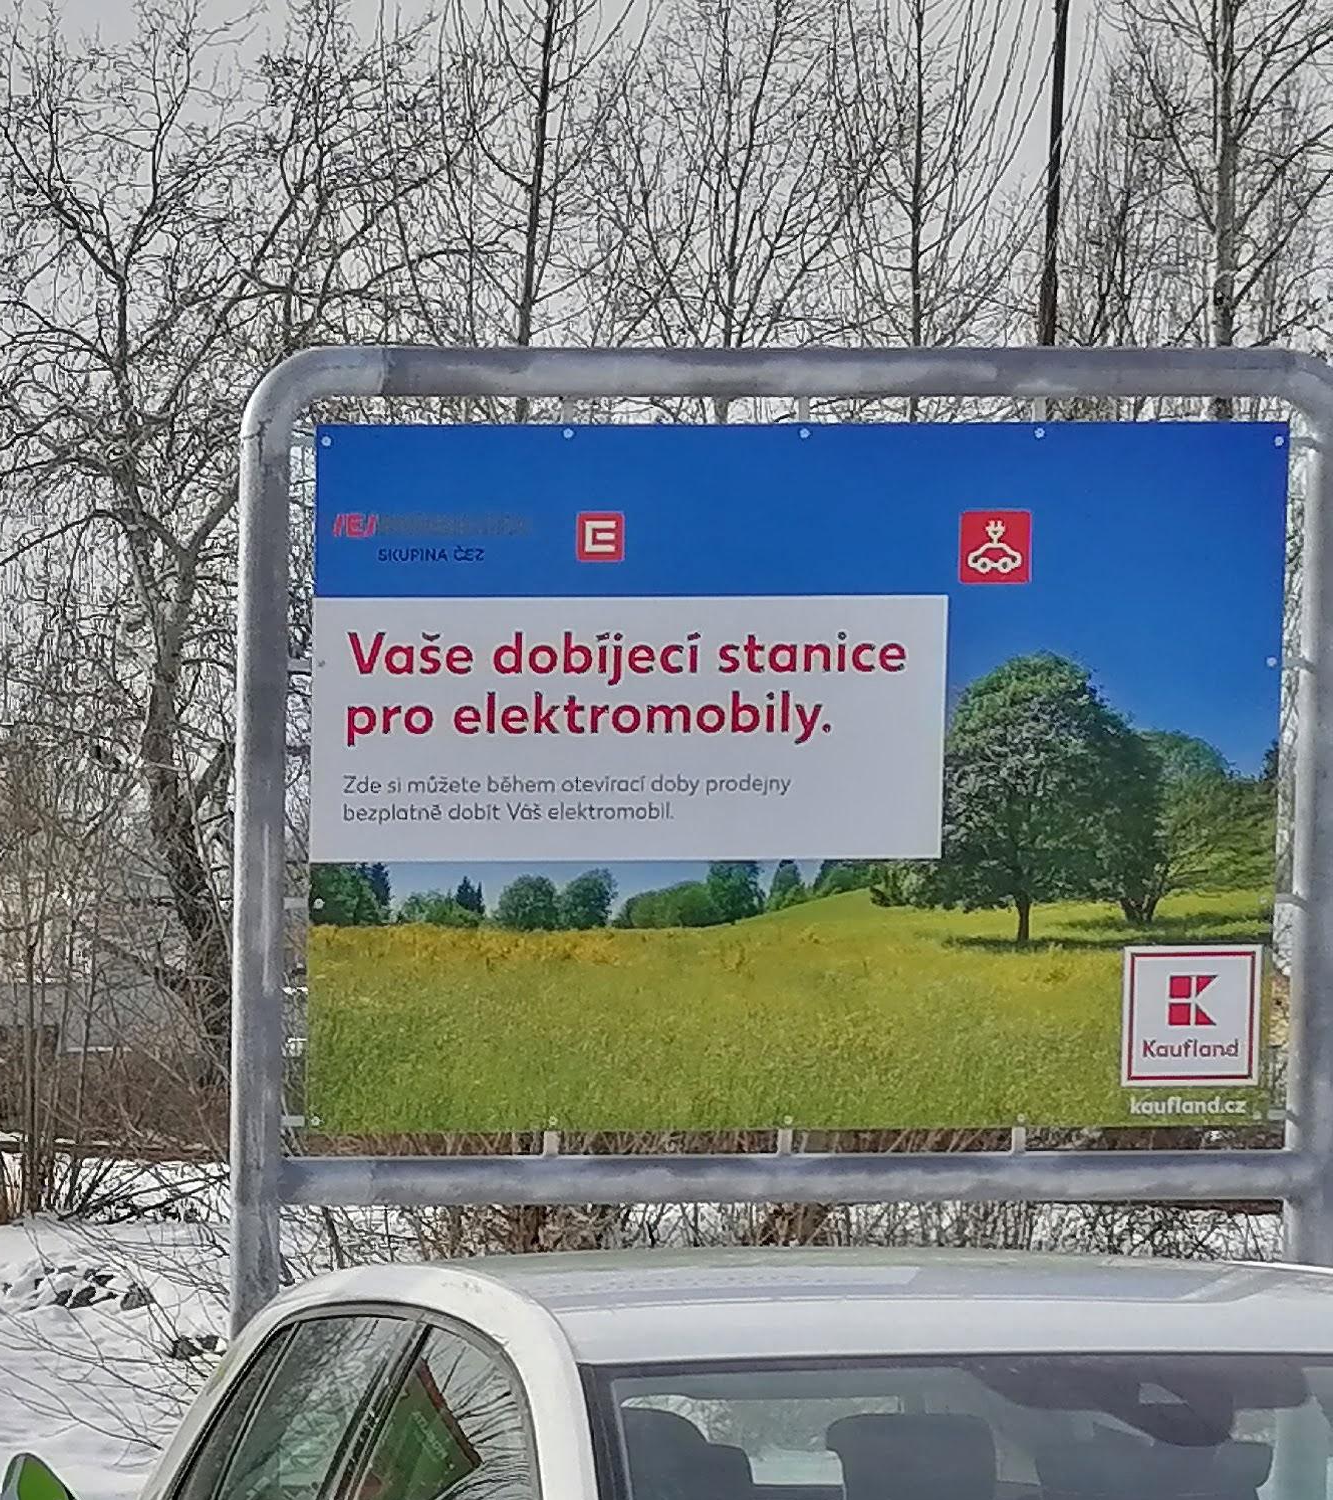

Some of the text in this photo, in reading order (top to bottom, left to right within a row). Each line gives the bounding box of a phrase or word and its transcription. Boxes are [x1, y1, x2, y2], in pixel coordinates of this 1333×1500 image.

[378, 545, 486, 562] SKUPINA ČEZ
[347, 631, 907, 686] Vaše dobíjecí stanice
[347, 690, 831, 748] pro elektromobily.
[343, 773, 791, 796] Zde si můžete během otevírací doby prodejny
[343, 801, 674, 824] bezplatně dobít Váš elektromobil.
[1142, 1038, 1239, 1058] Kaufland
[1130, 1096, 1246, 1115] kaufland.cz
